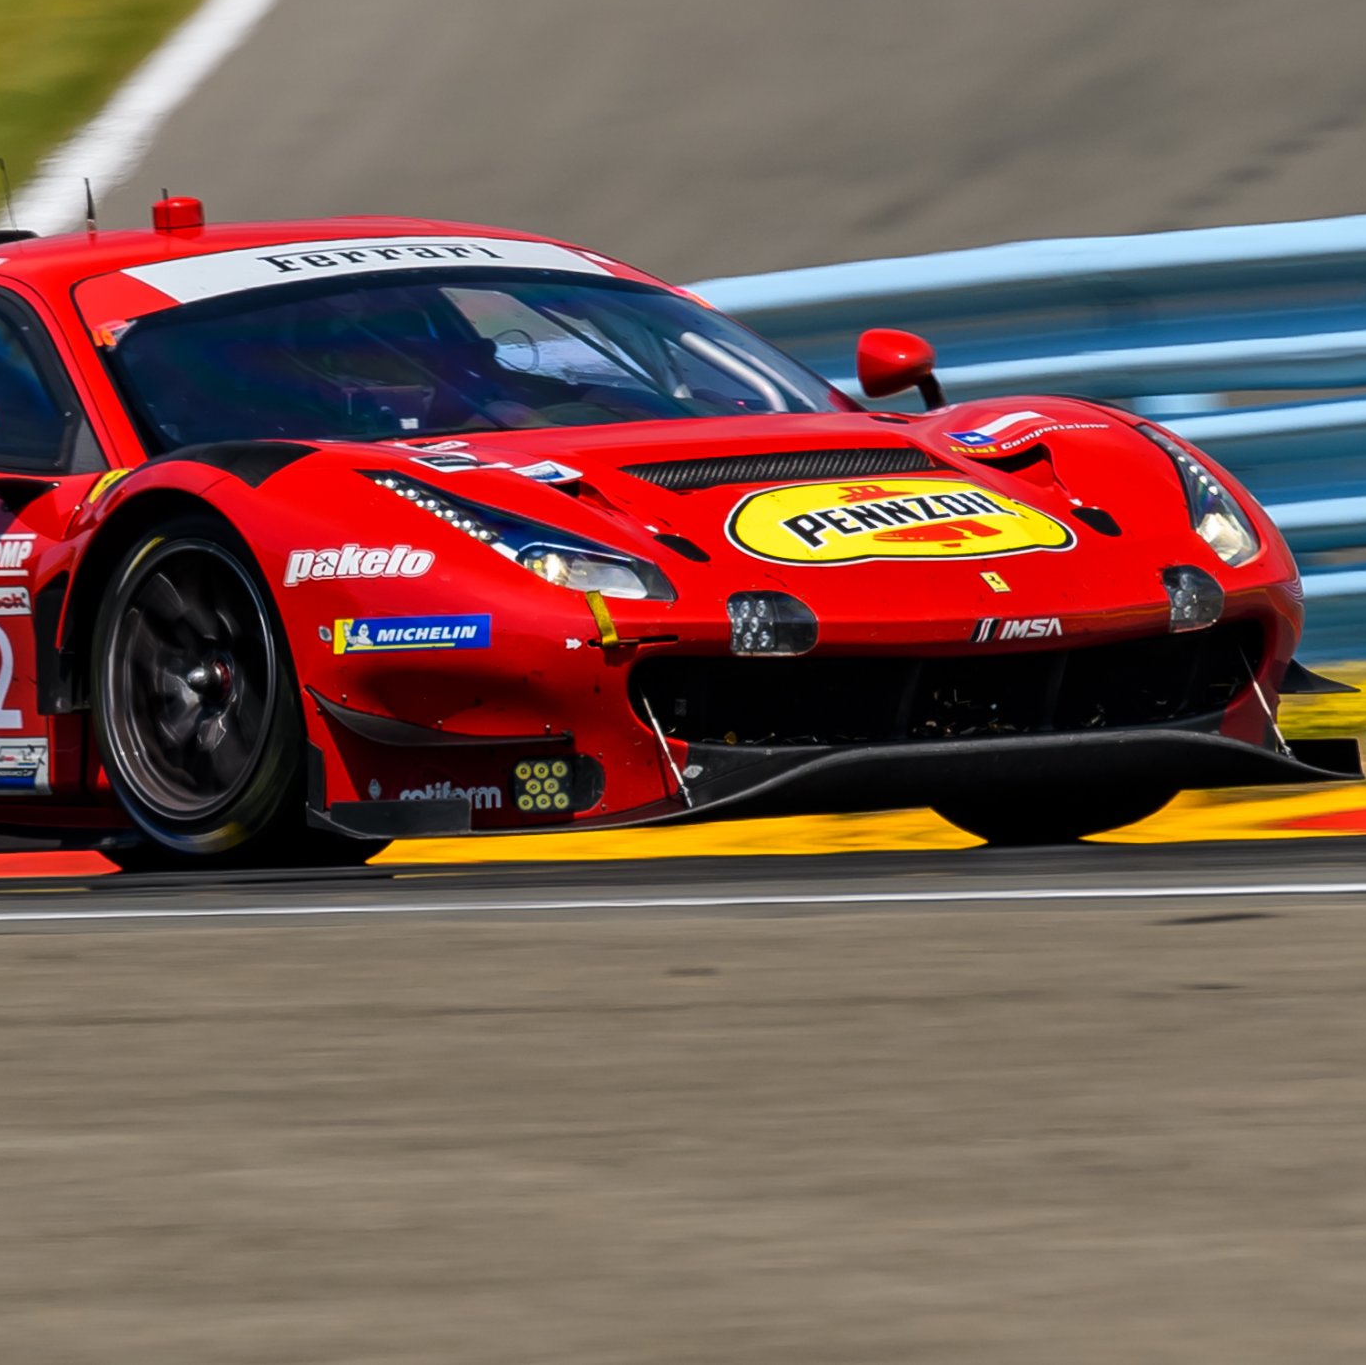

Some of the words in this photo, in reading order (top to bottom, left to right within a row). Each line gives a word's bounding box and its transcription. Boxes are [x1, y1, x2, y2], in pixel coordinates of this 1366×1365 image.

[255, 243, 503, 273] Ferrari
[1000, 422, 1110, 450] Competizione
[782, 490, 1019, 549] PENNZOIL
[284, 544, 435, 586] pakelo
[376, 625, 478, 643] MICHELIN
[998, 617, 1063, 641] IMSA
